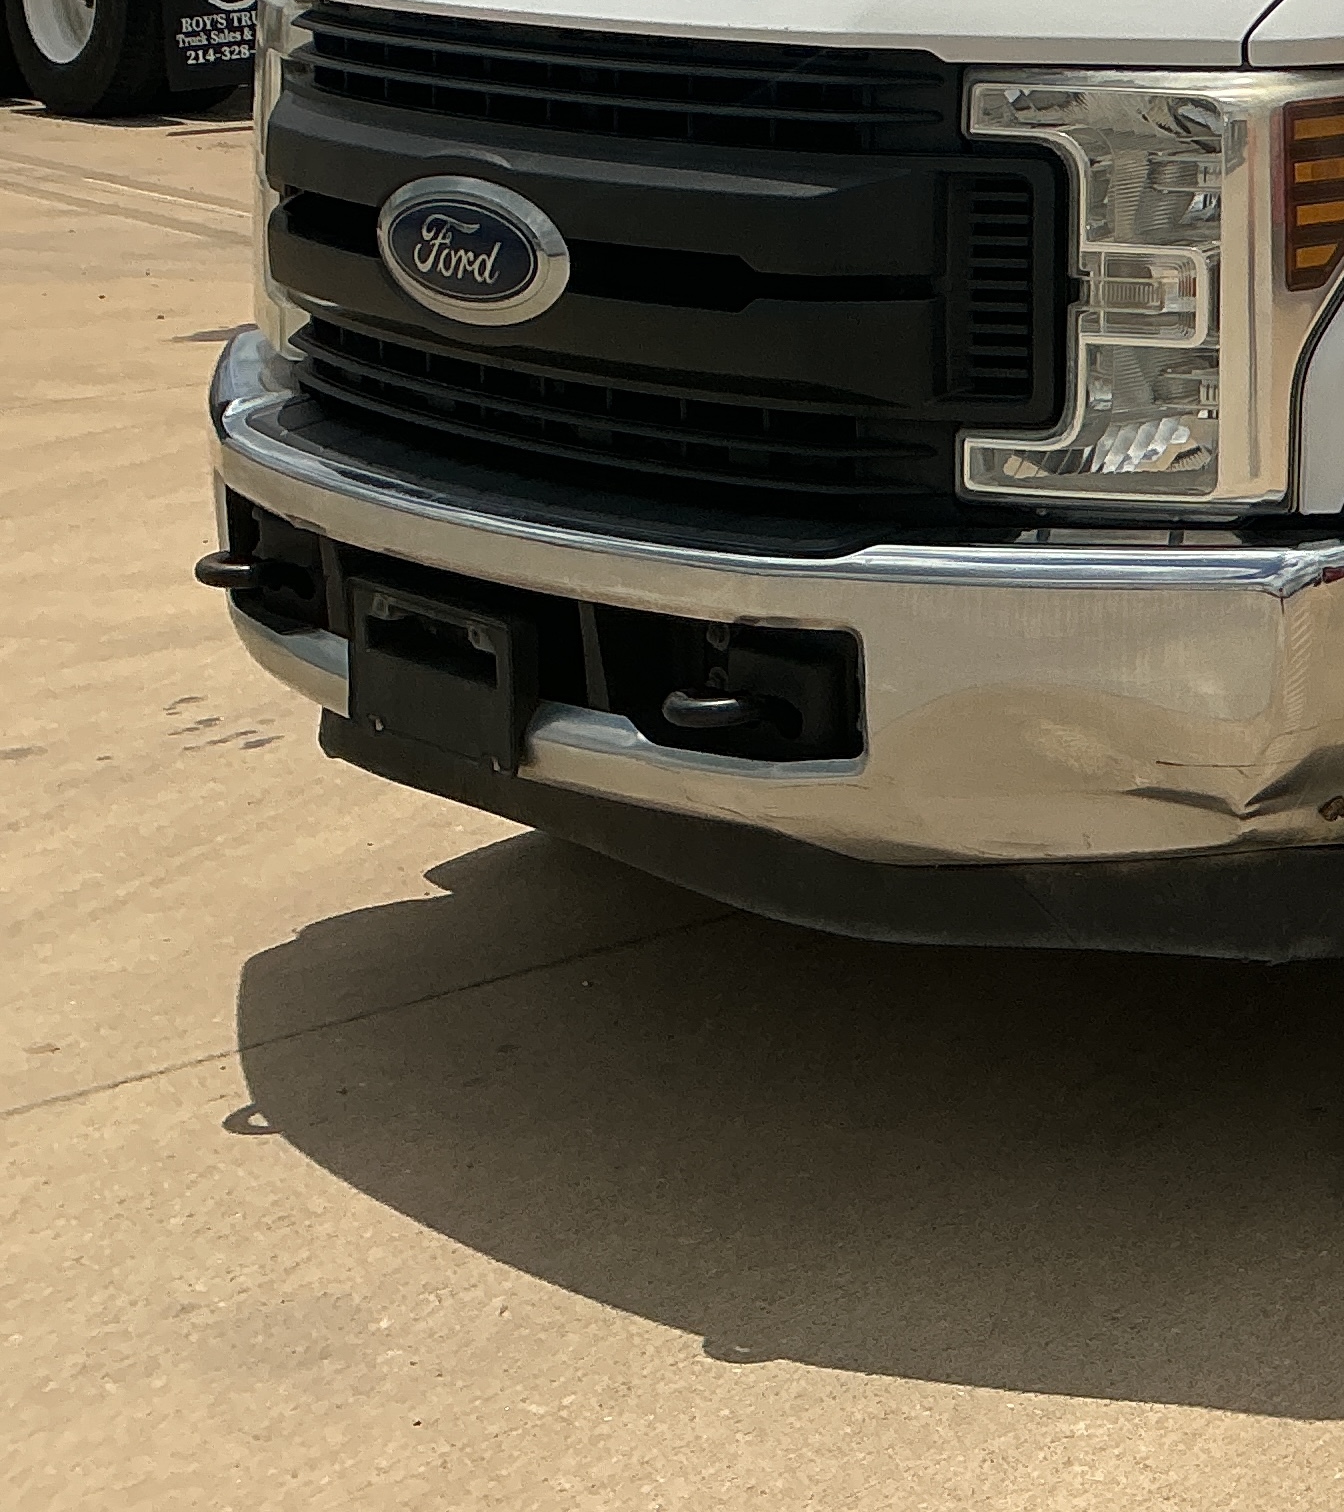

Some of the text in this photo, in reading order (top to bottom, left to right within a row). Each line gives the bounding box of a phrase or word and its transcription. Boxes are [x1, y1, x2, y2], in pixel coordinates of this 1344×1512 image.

[180, 13, 227, 33] ROY'S
[210, 28, 242, 45] Sales
[243, 26, 254, 41] &
[413, 213, 502, 285] Ford
